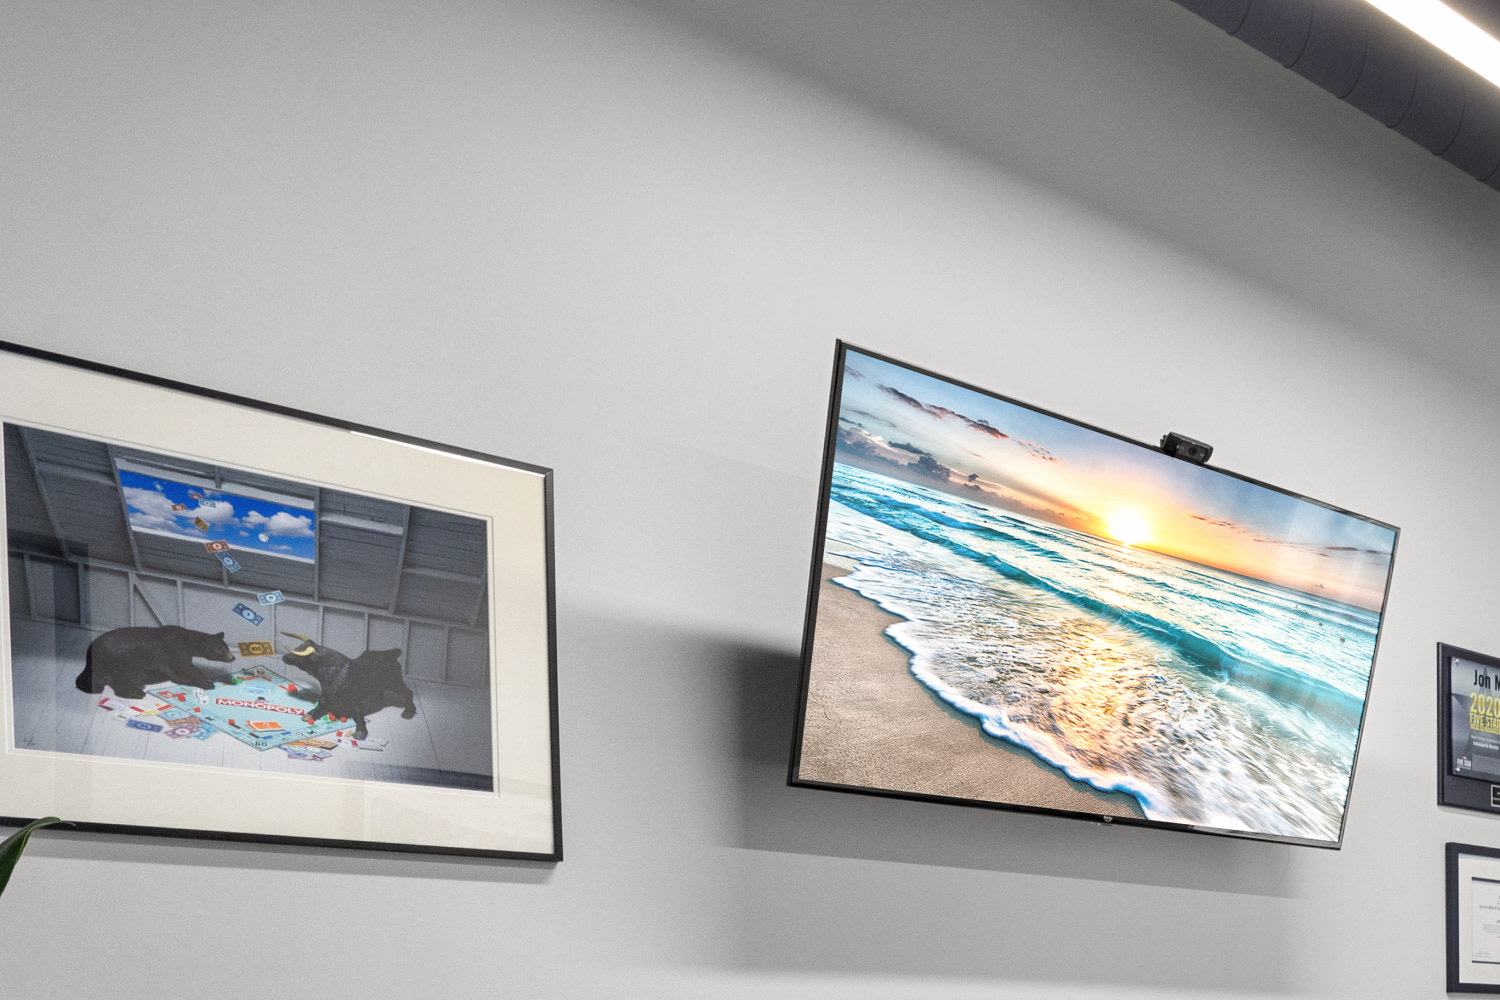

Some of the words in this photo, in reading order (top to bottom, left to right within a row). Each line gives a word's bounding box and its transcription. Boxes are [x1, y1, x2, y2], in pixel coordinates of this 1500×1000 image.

[1473, 669, 1491, 689] Jon
[217, 698, 305, 715] MONOPOLY
[1470, 713, 1485, 726] FIVE
